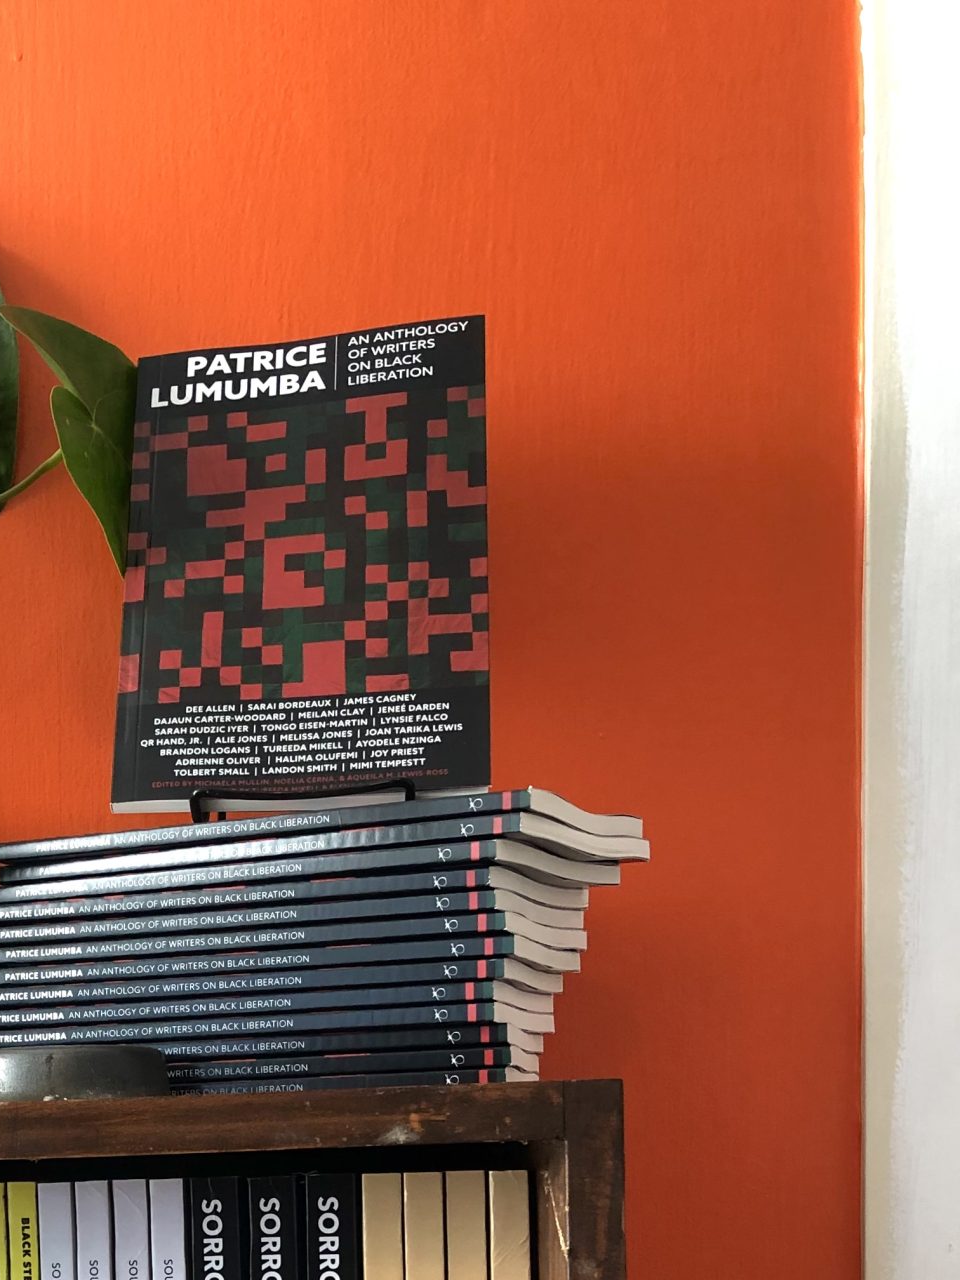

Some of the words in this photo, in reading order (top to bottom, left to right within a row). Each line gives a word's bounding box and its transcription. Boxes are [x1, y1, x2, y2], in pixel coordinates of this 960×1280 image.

[347, 334, 369, 346] AN
[373, 320, 468, 342] ANTHOLOGY
[347, 347, 368, 358] OF
[370, 338, 435, 355] WRITERS
[186, 342, 327, 378] PATRICE
[347, 360, 370, 372] ON
[374, 353, 421, 368] BLACK
[347, 365, 433, 385] LIBERATION
[150, 370, 326, 408] LUMUMBA
[153, 715, 192, 725] DAJAUN
[194, 711, 286, 723] CARTER-WOODARD
[298, 708, 337, 718] MEILANI
[339, 707, 365, 716] CLAY
[377, 703, 406, 714] JENEÉ
[408, 703, 449, 713] DARDEN
[185, 704, 203, 713] DEE
[205, 703, 235, 712] ALLEN
[247, 701, 276, 710] SARAI
[278, 698, 330, 709] BORDEAUX
[343, 696, 370, 705] JAMES
[373, 694, 416, 704] CAGNEY
[140, 738, 154, 747] QR
[156, 737, 186, 746] HAND,
[188, 736, 202, 744] JR.
[214, 734, 235, 743] ALIE
[237, 732, 267, 742] JONES
[279, 730, 319, 740] MELISSA
[321, 728, 352, 738] JONES
[365, 726, 390, 735] JOAN
[393, 724, 430, 734] TARIKA
[432, 722, 463, 732] LEWIS
[154, 726, 187, 735] SARAH
[189, 724, 225, 734] DUDZIC
[227, 723, 248, 732] IYER
[260, 721, 296, 730] TONGO
[298, 717, 368, 729] EISEN-MARTIN
[380, 715, 413, 725] LYNSIE
[415, 714, 448, 723] FALCO
[159, 745, 208, 755] BRANDON
[210, 743, 250, 753] LOGANS
[262, 741, 306, 751] TUREEDA
[308, 739, 342, 749] MIKELL
[355, 737, 399, 747] AYODELE
[402, 735, 441, 745] NZINGA
[175, 756, 224, 766] ADRIENNE
[226, 755, 260, 764] OLIVER
[275, 752, 313, 762] HALIMA
[315, 750, 357, 760] OLUFEMI
[370, 749, 388, 758] JOY
[390, 747, 424, 757] PRIEST
[174, 767, 216, 777] TOLBERT
[218, 766, 249, 775] SMALL
[262, 763, 303, 773] LANDON
[306, 762, 337, 771] SMITH
[349, 760, 371, 769] MIMI
[374, 758, 425, 768] TEMPESTT
[0, 908, 31, 919] PATRICE
[33, 905, 74, 916] LUMUMBA
[78, 904, 90, 913] AN
[92, 900, 143, 912] ANTHOLOGY
[145, 899, 156, 908] OF
[160, 896, 196, 907] WRITERS
[198, 895, 211, 904] ON
[213, 893, 241, 903] BLACK
[243, 889, 294, 901] LIBERATION
[24, 1031, 66, 1041] LUMUMBA
[70, 1030, 82, 1039] AN
[85, 1027, 138, 1038] ANTHOLOGY
[141, 1027, 152, 1035] OF
[154, 1025, 192, 1035] WRITERS
[195, 1024, 208, 1032] ON
[211, 1022, 239, 1032] BLACK
[241, 1019, 293, 1030] LIBERATION
[21, 1217, 30, 1257] BLACK
